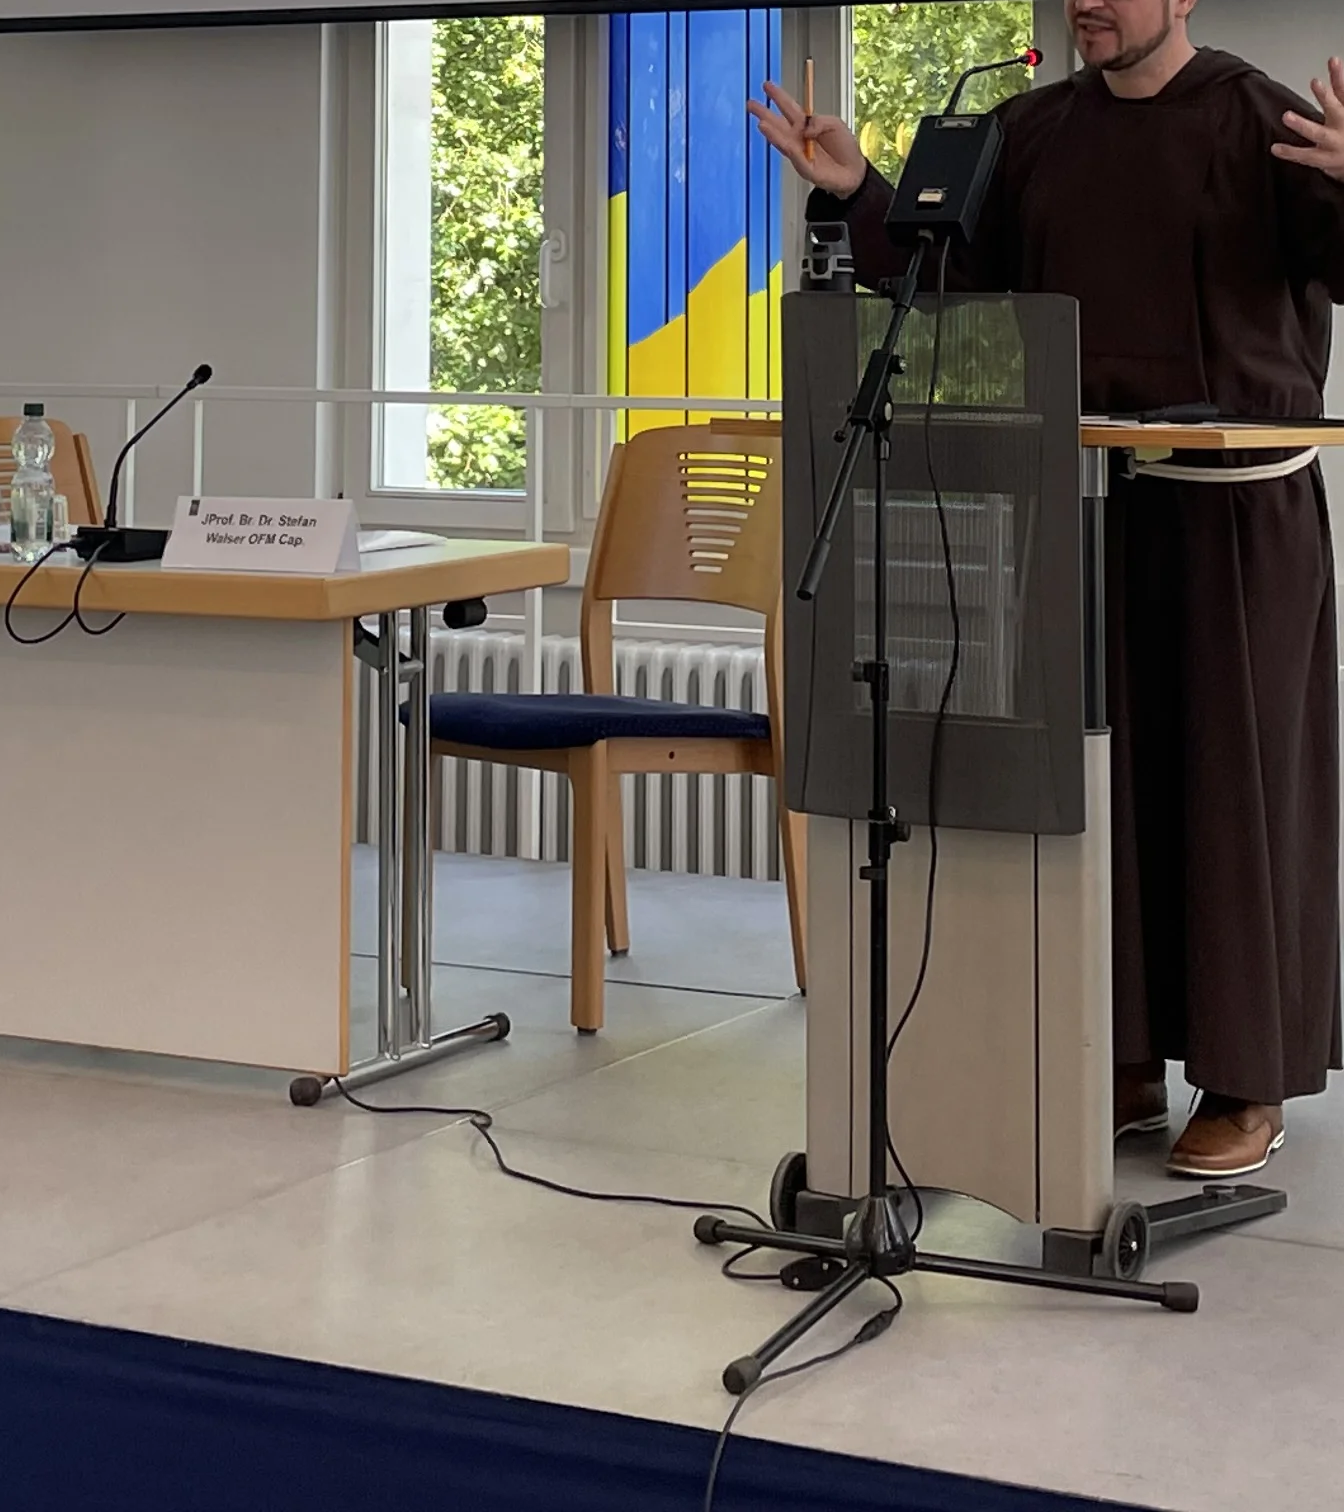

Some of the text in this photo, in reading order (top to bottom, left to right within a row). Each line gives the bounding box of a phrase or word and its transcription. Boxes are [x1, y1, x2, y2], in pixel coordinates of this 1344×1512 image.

[277, 514, 318, 527] Stefan
[205, 532, 246, 545] Walser
[247, 533, 276, 545] OFM
